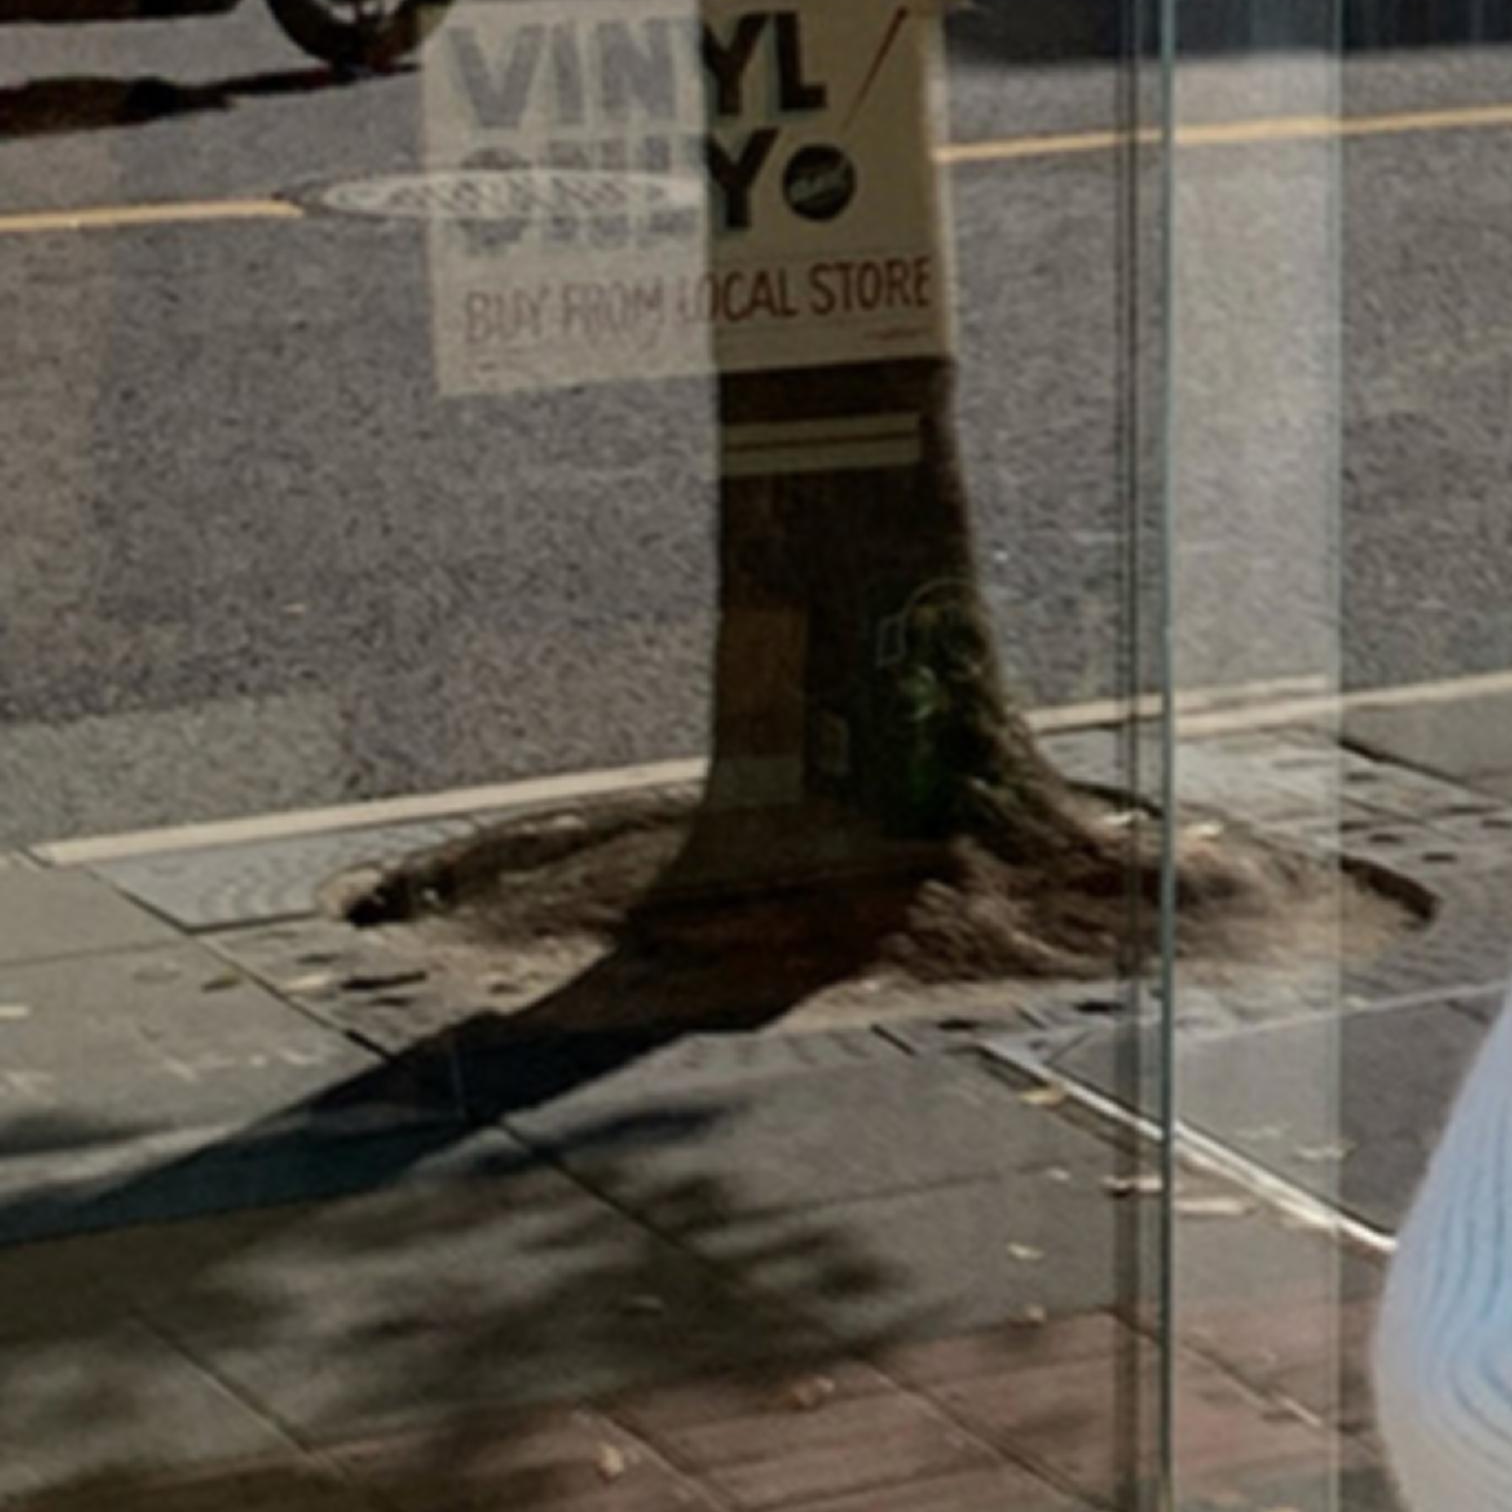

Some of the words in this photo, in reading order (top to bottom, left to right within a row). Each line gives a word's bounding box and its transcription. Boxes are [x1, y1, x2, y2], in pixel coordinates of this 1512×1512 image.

[444, 9, 828, 129] VINYL
[463, 286, 551, 345] BUY
[562, 277, 666, 334] FROM
[675, 267, 798, 324] LOCAL
[808, 255, 934, 316] STORE
